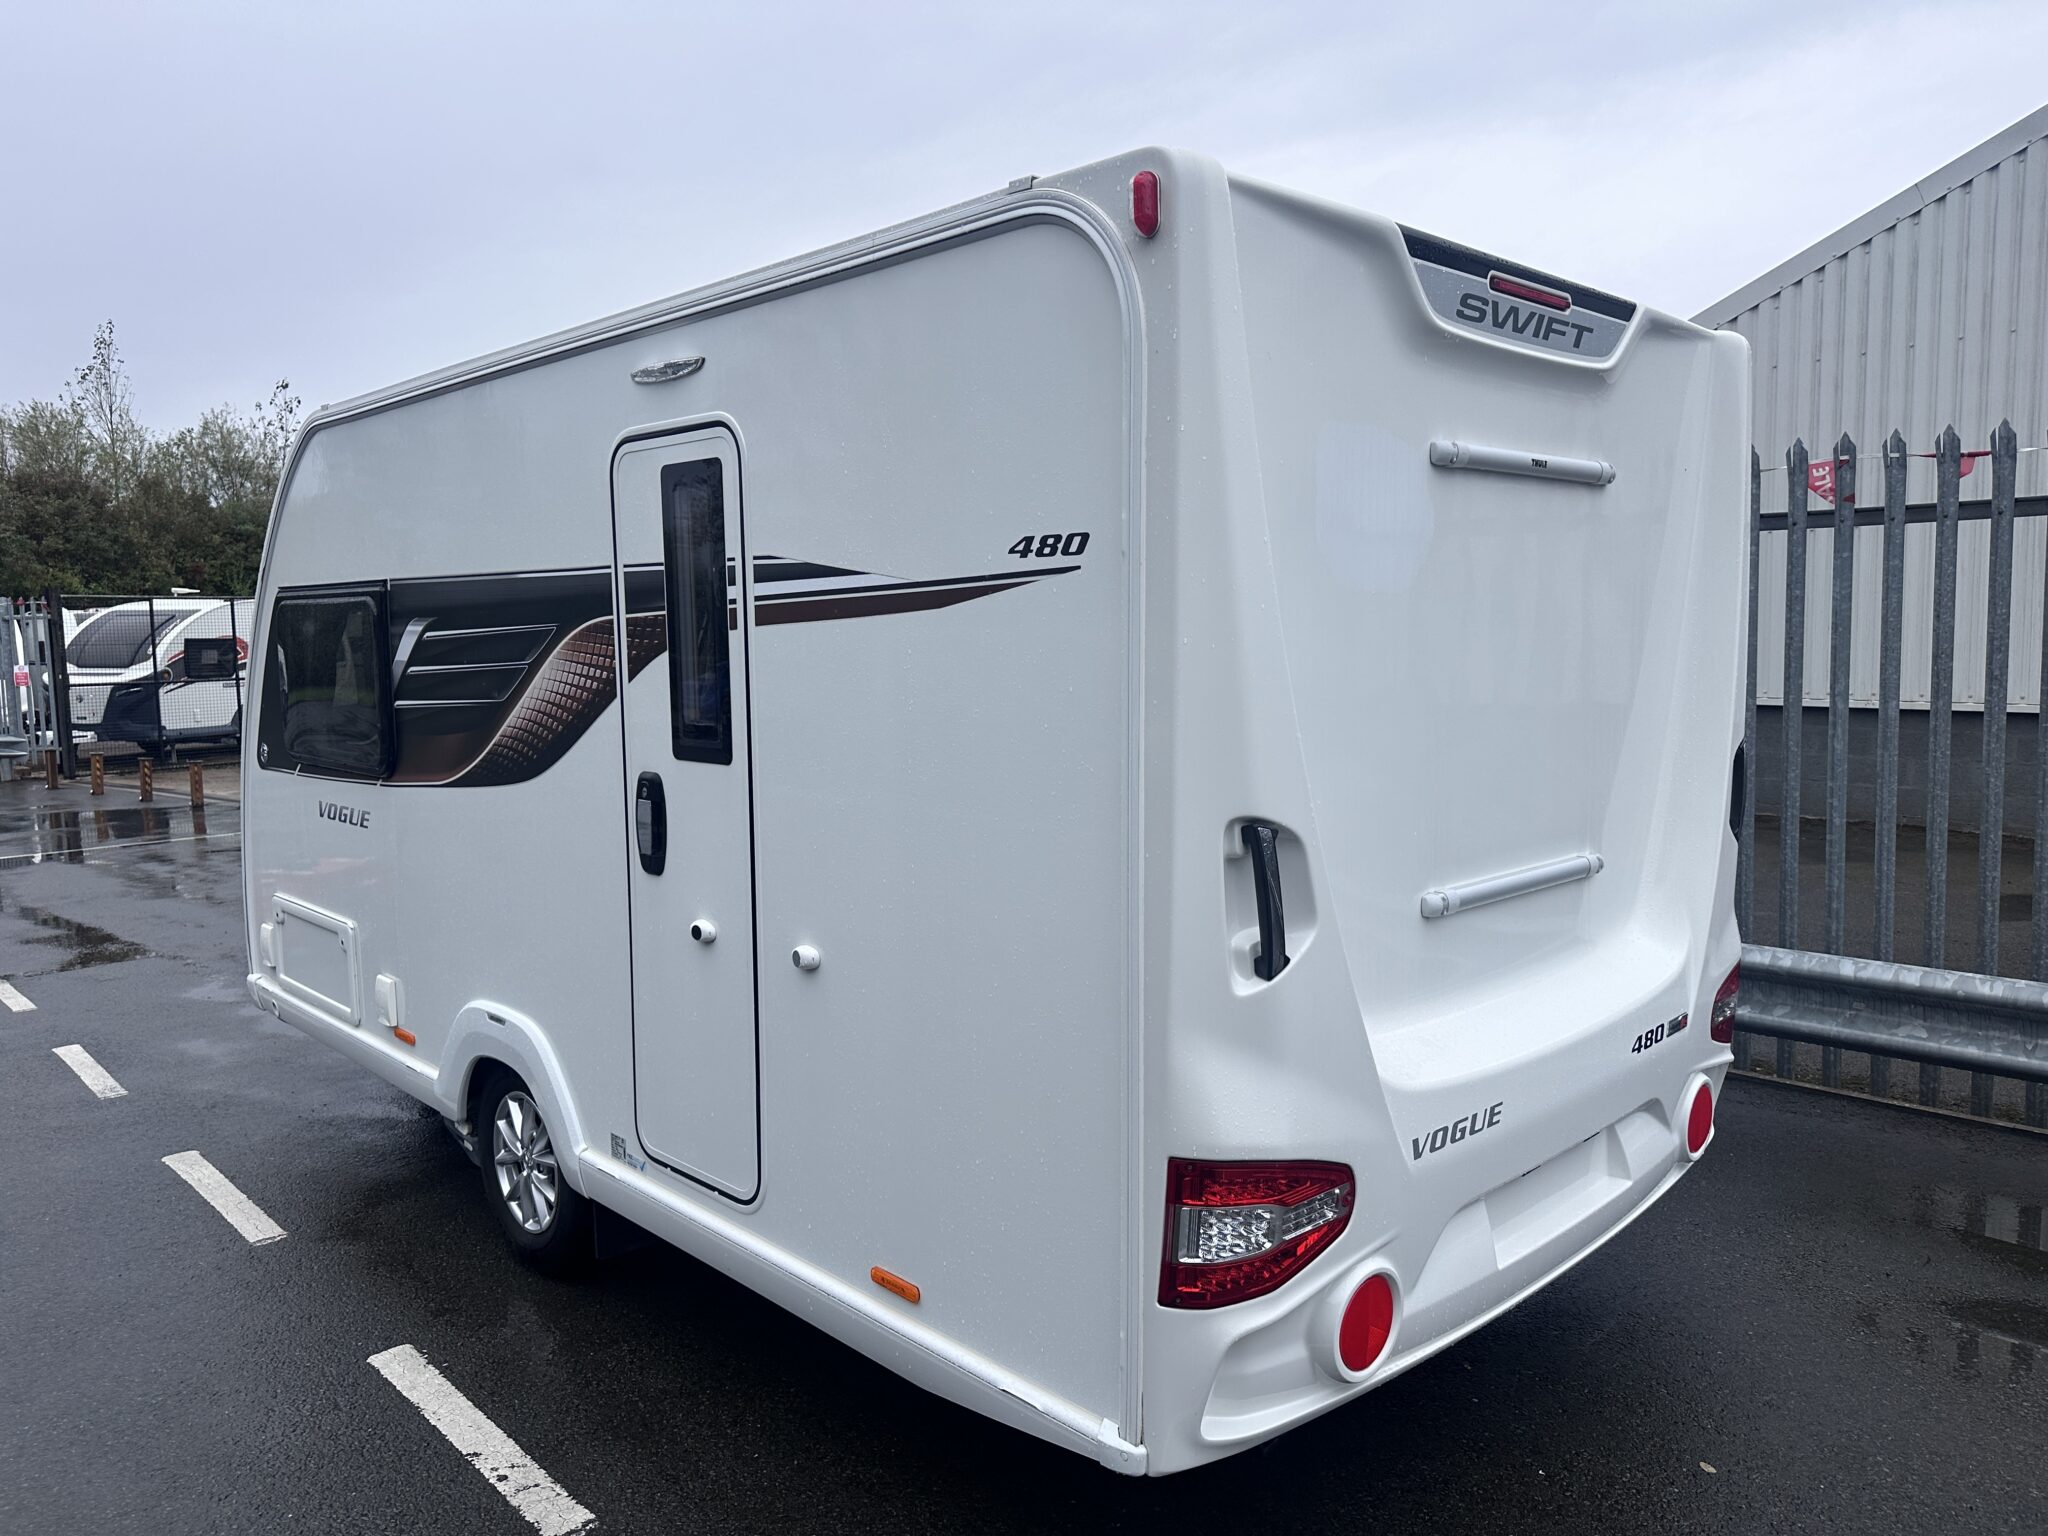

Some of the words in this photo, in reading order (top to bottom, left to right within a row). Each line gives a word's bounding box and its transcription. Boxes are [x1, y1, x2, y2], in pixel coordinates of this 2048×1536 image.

[1455, 292, 1594, 349] SWIFT
[1007, 532, 1090, 559] 480
[318, 800, 371, 829] VOGUE
[1631, 1022, 1665, 1055] 480
[1412, 1101, 1503, 1161] VOGUE
